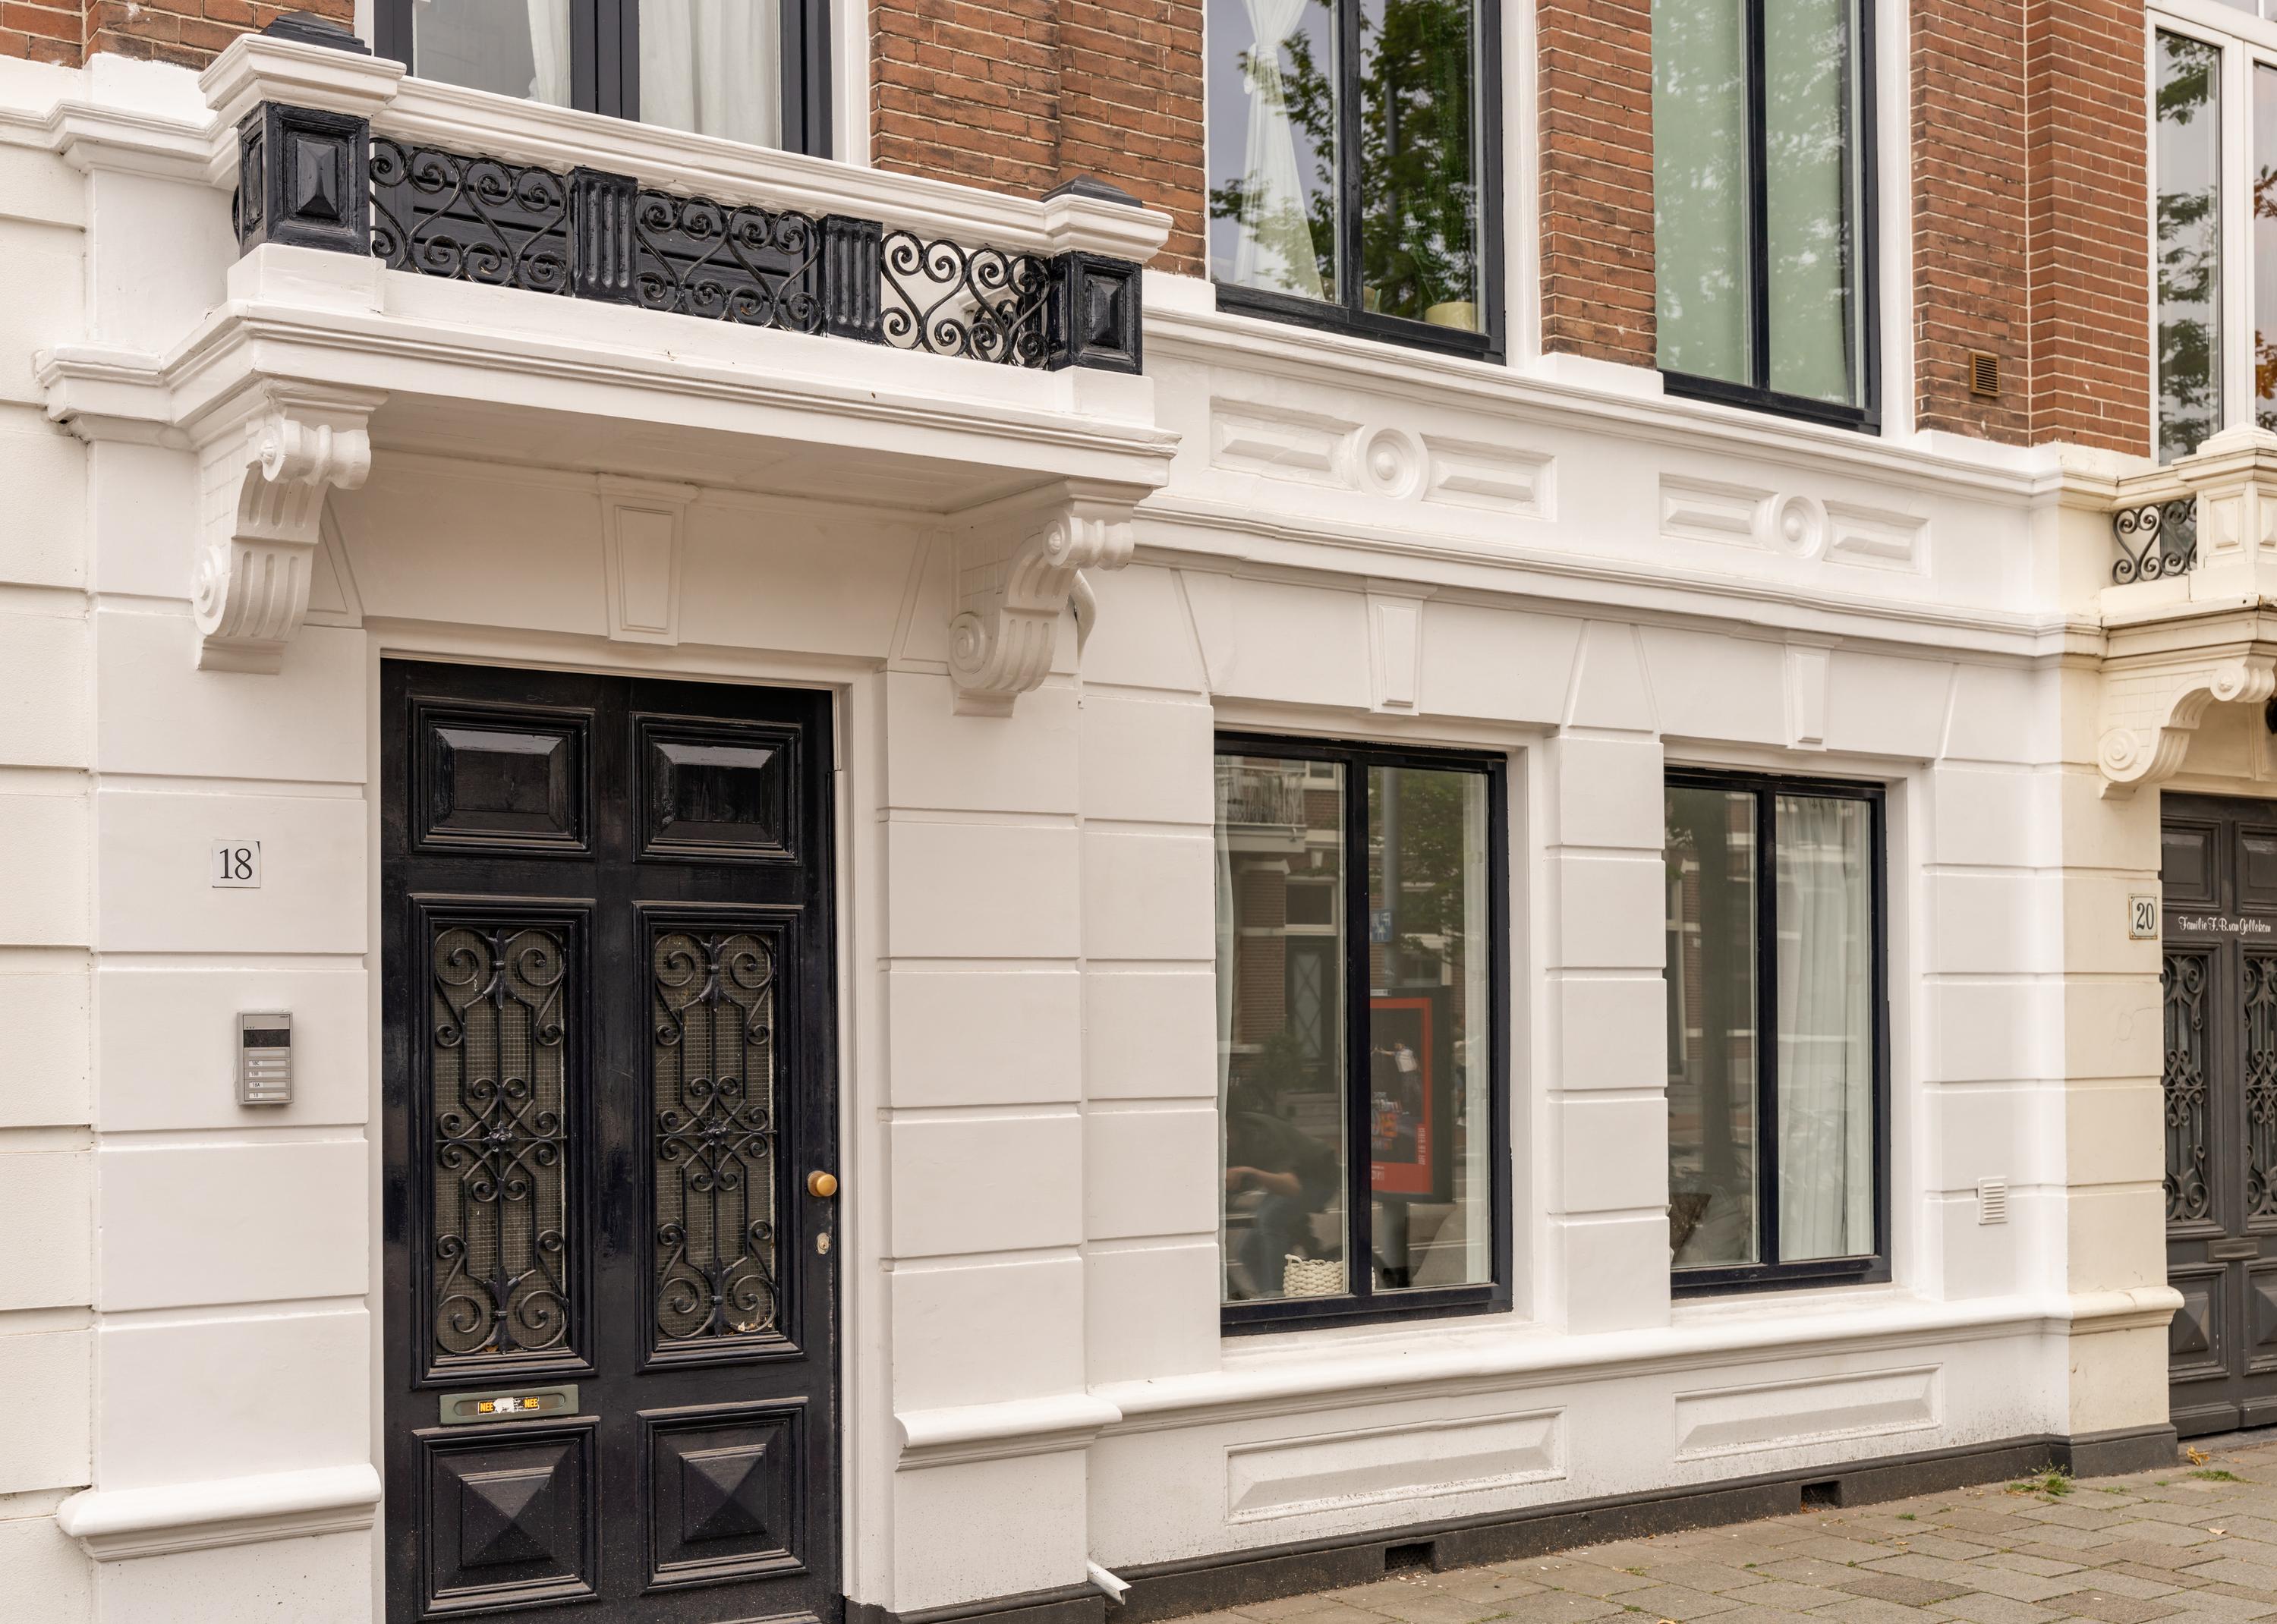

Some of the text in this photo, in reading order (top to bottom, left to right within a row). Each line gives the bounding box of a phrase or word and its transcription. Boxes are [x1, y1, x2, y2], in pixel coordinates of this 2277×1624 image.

[219, 848, 252, 880] 18
[2137, 902, 2154, 930] 20
[2178, 916, 2207, 930] Familie
[480, 1402, 493, 1412] NEE
[524, 1399, 537, 1408] NEE
